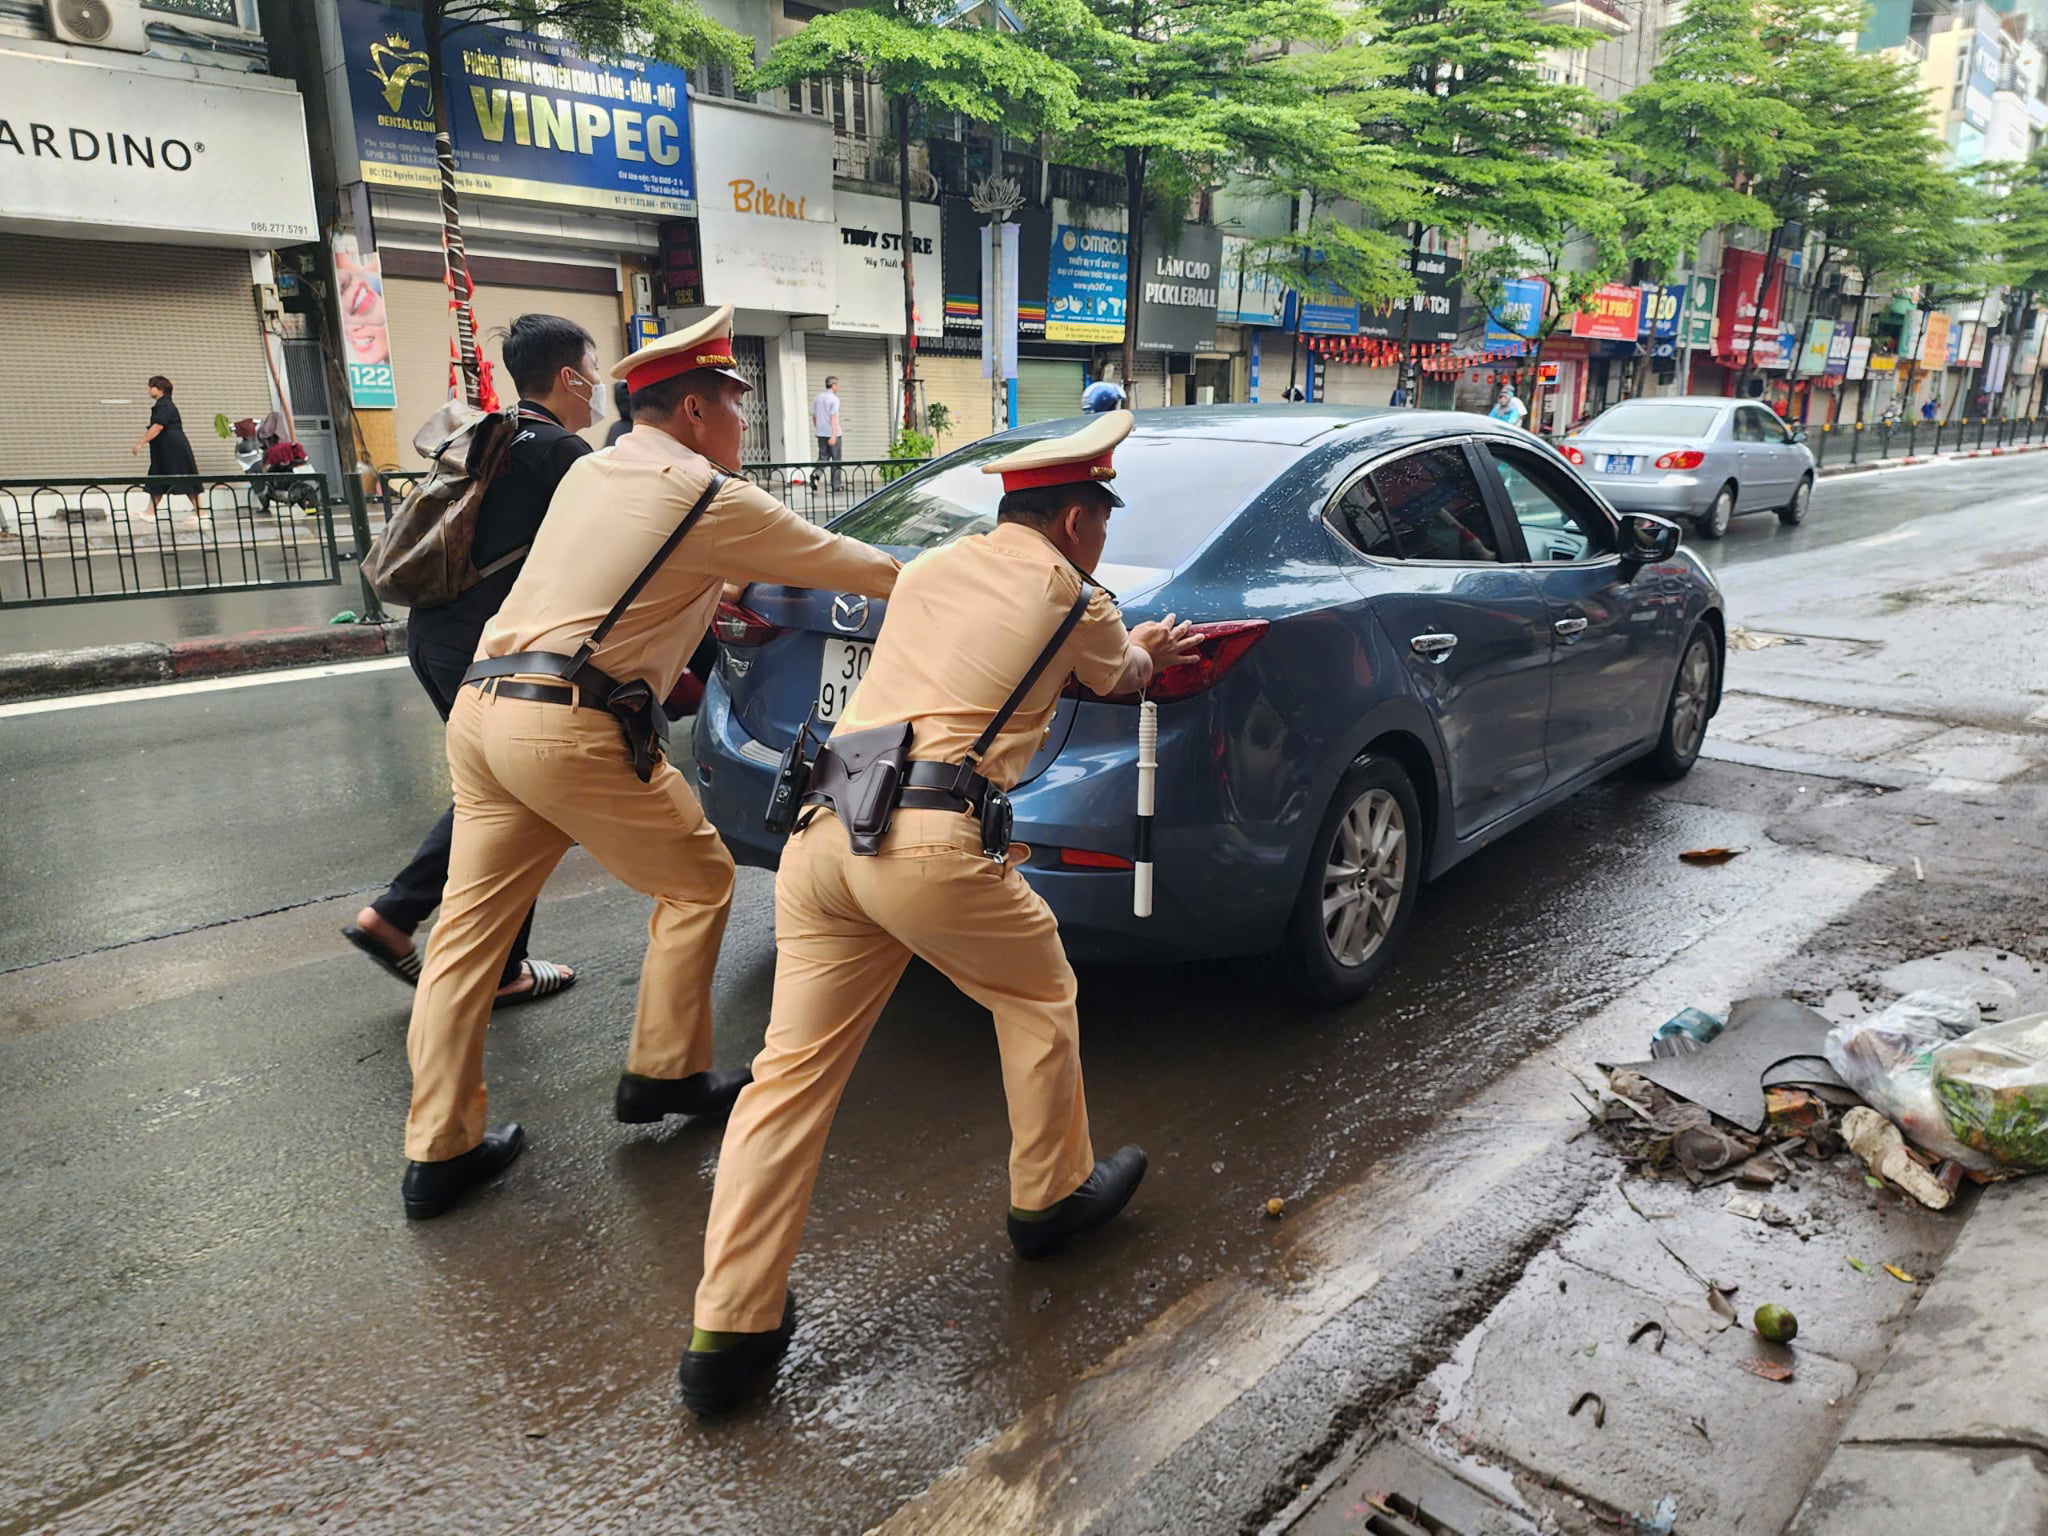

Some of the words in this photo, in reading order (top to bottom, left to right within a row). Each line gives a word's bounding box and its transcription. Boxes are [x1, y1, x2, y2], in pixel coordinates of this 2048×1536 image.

[377, 114, 411, 130] DENTAL
[412, 117, 438, 133] CLINI
[469, 85, 681, 167] VINPEC
[728, 178, 806, 220] Bikini
[881, 232, 933, 255] STRE
[1080, 235, 1127, 256] OMRON
[1185, 261, 1210, 280] CAO
[1145, 281, 1217, 308] PICKLEBALL
[1413, 294, 1450, 315] WATCH
[351, 366, 391, 386] 122
